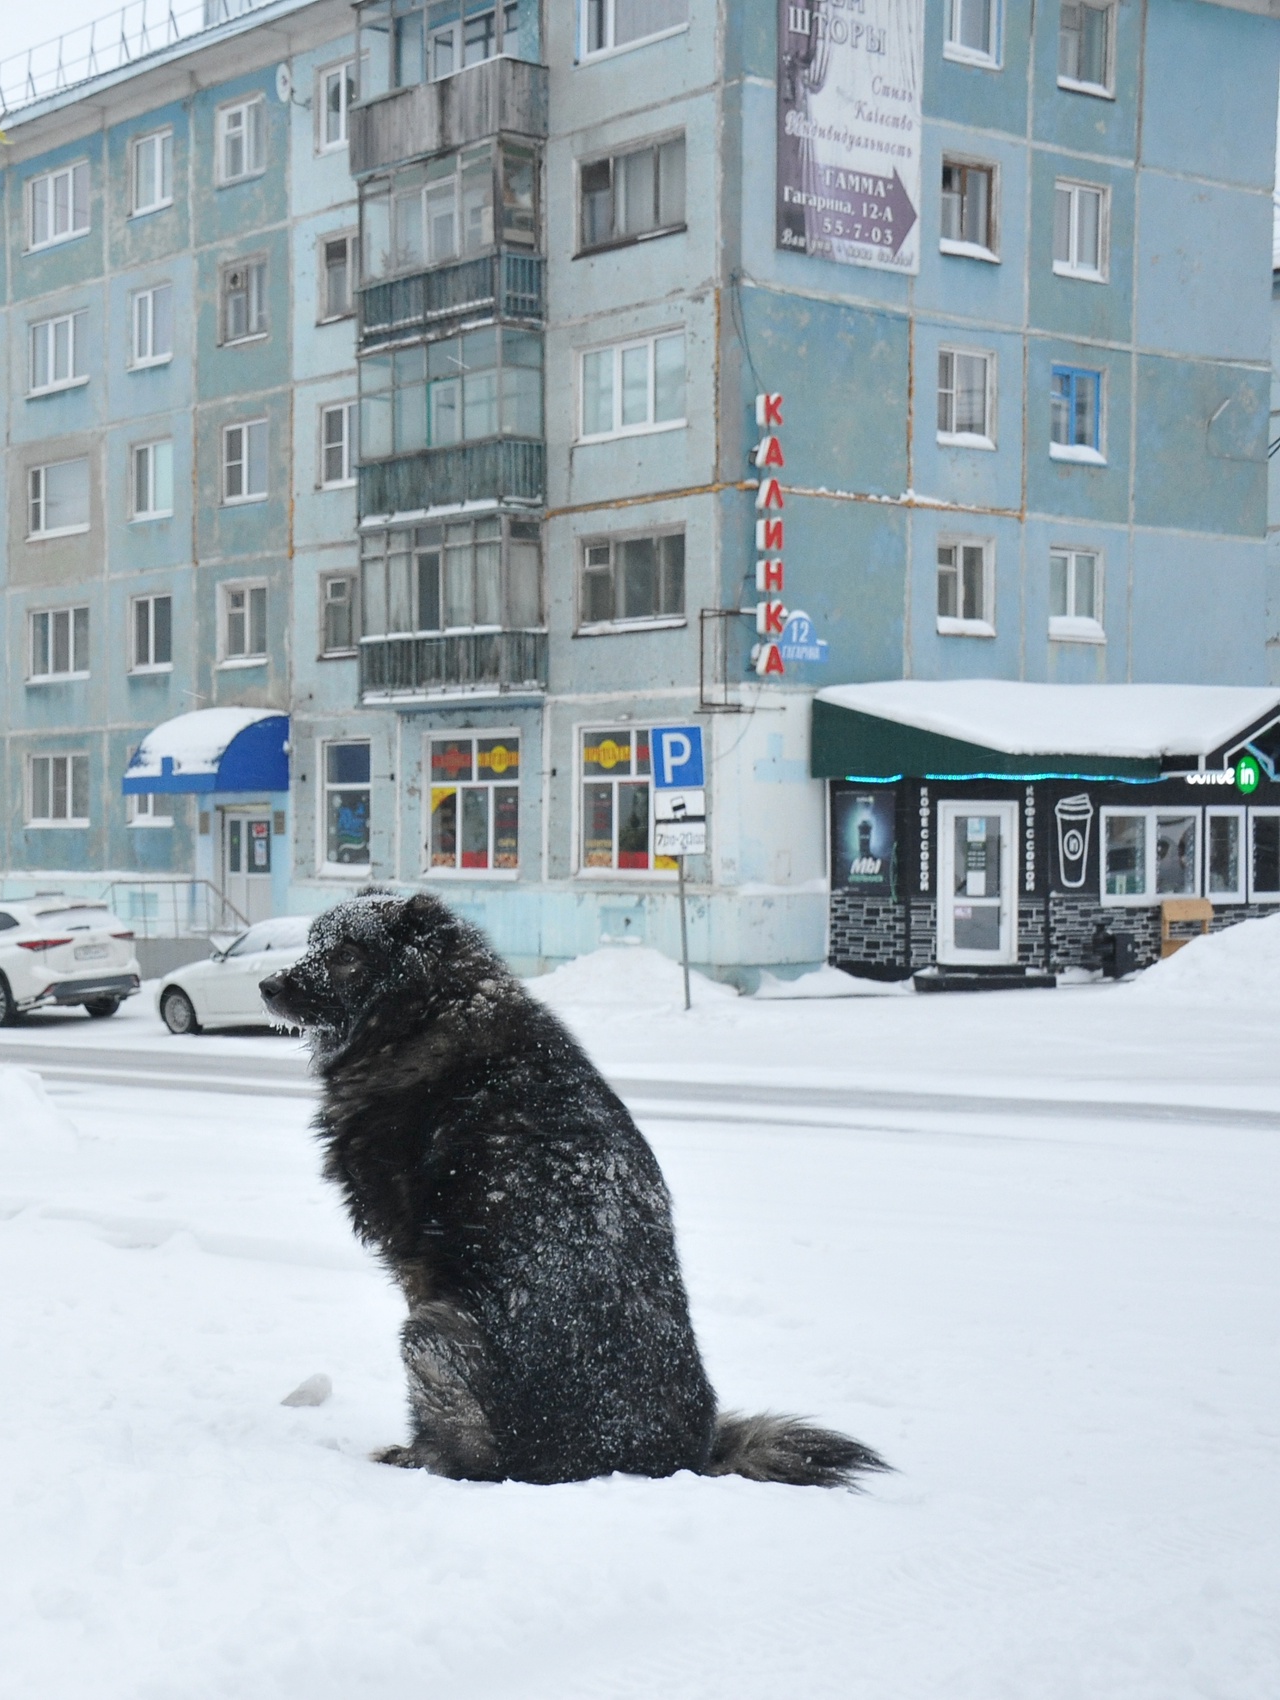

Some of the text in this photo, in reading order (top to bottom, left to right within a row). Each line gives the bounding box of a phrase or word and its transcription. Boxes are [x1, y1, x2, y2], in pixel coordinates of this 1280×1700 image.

[788, 6, 887, 56] ШТОРЫ
[871, 75, 913, 103] Стиль
[784, 109, 913, 158] Индивидуальность
[854, 99, 913, 132] Качество
[783, 185, 894, 222] Гагарина, 12-А
[759, 392, 785, 676] КАЛИНКА
[791, 620, 809, 644] 12
[662, 732, 692, 784] P
[1240, 762, 1255, 785] in
